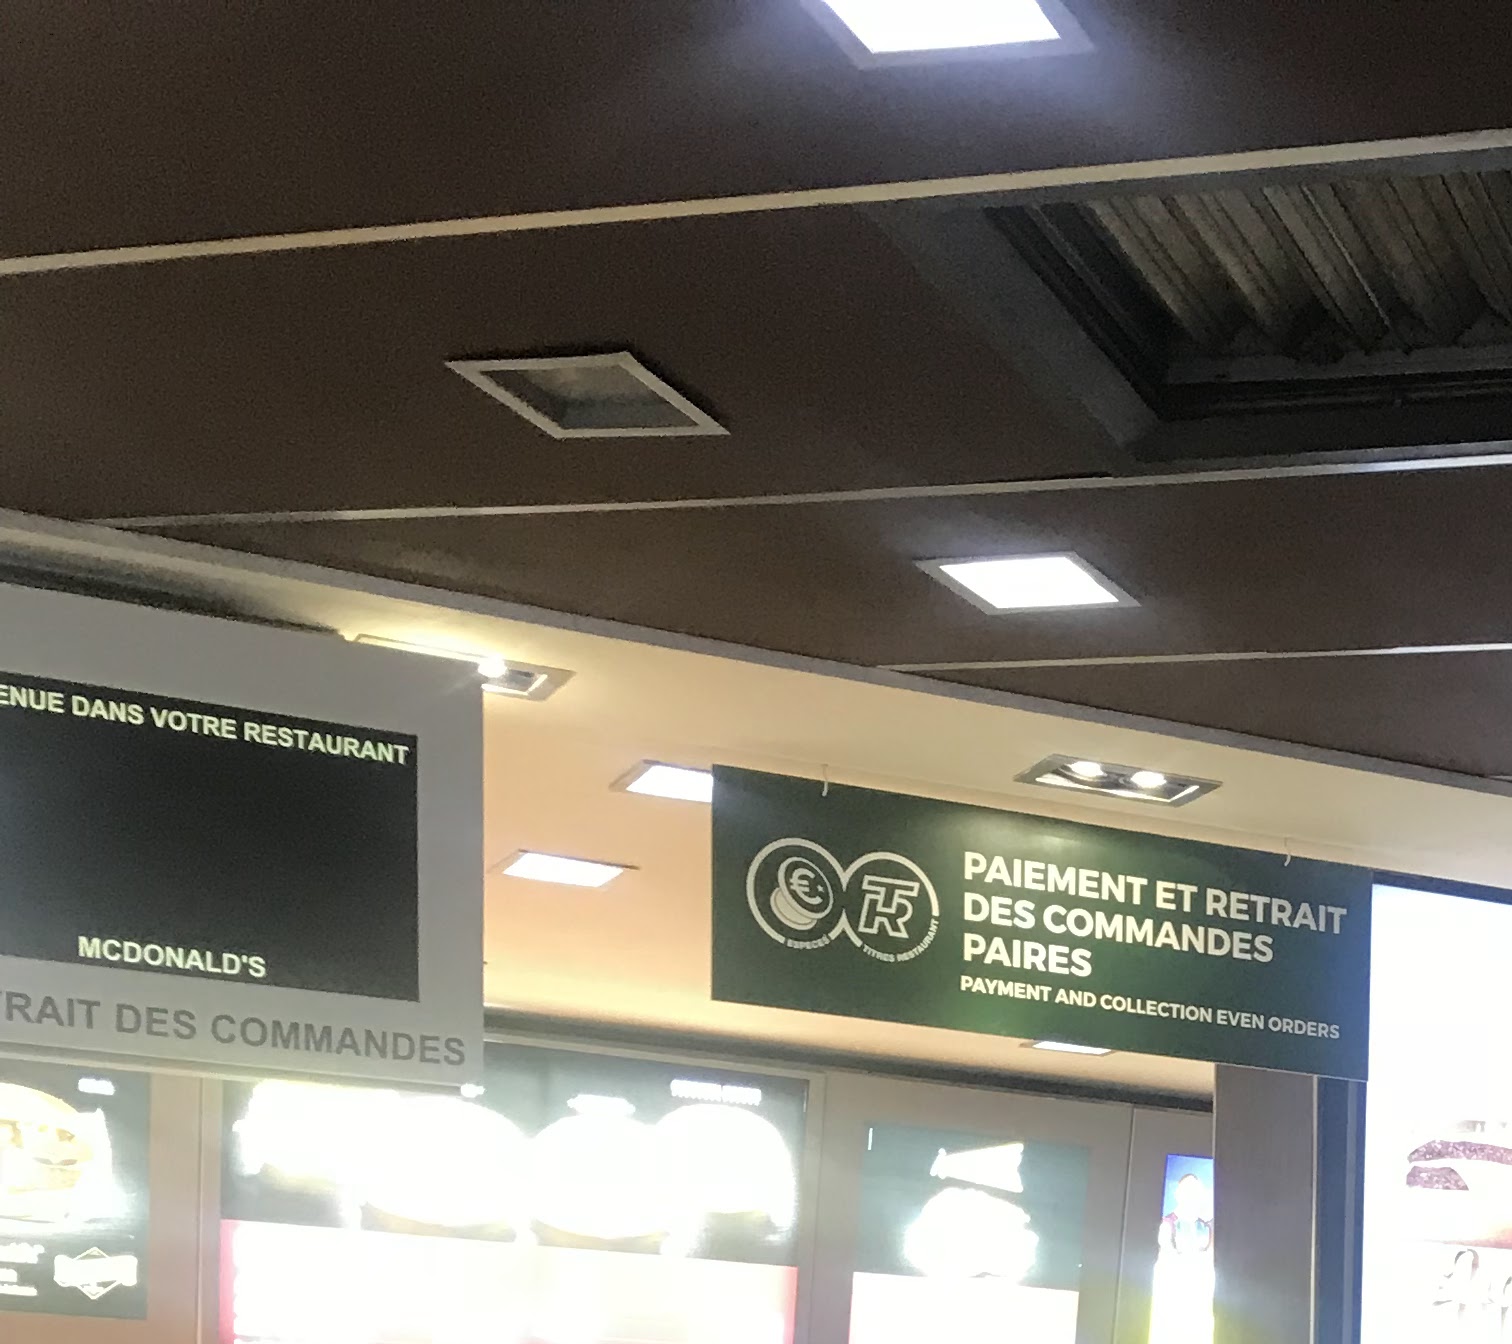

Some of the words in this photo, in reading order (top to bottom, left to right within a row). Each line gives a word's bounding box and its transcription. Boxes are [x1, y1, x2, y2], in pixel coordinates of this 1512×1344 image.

[71, 695, 144, 725] DANS
[150, 707, 237, 739] VOTRE
[243, 721, 410, 765] RESTAURANT
[964, 851, 1148, 905] PAIEMENT
[1156, 880, 1198, 912] ET
[1206, 887, 1347, 935] RETRAIT
[78, 936, 266, 978] MCDONALD'S
[896, 918, 940, 963] RESTAURANT
[963, 892, 1036, 929] DES
[1043, 904, 1274, 963] COMMANDES
[963, 932, 1093, 977] PAIRES
[0, 989, 101, 1030] RAIT
[115, 1003, 197, 1040] DES
[211, 1014, 466, 1066] COMMANDES
[960, 975, 1052, 1002] PAYMENT
[1054, 988, 1097, 1008] AND
[1100, 994, 1212, 1024] COLLECTION
[1216, 1009, 1264, 1030] EVEN
[1268, 1016, 1340, 1039] ORDERS
